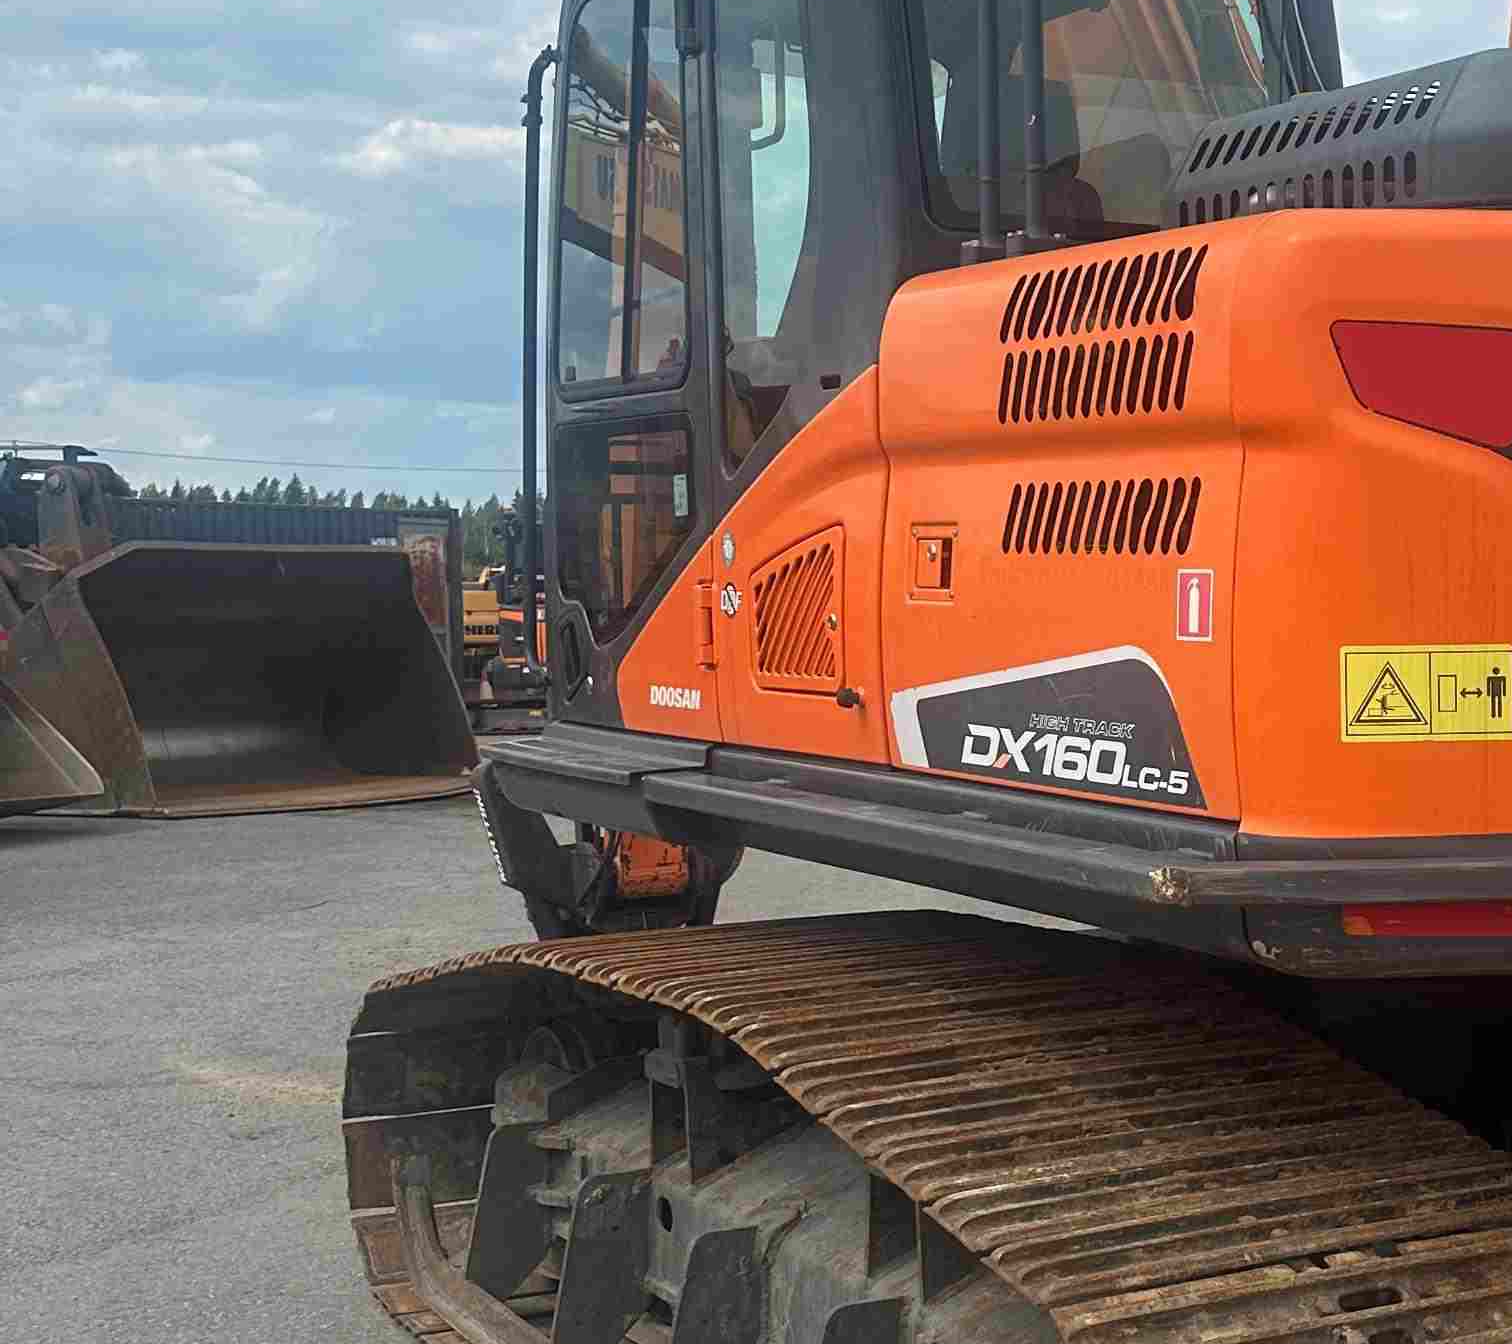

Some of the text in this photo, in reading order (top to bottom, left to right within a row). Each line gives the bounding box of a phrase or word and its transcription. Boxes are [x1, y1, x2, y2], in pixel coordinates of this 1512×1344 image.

[649, 684, 702, 711] DOOSAN
[1029, 712, 1136, 740] HIGH TRACK
